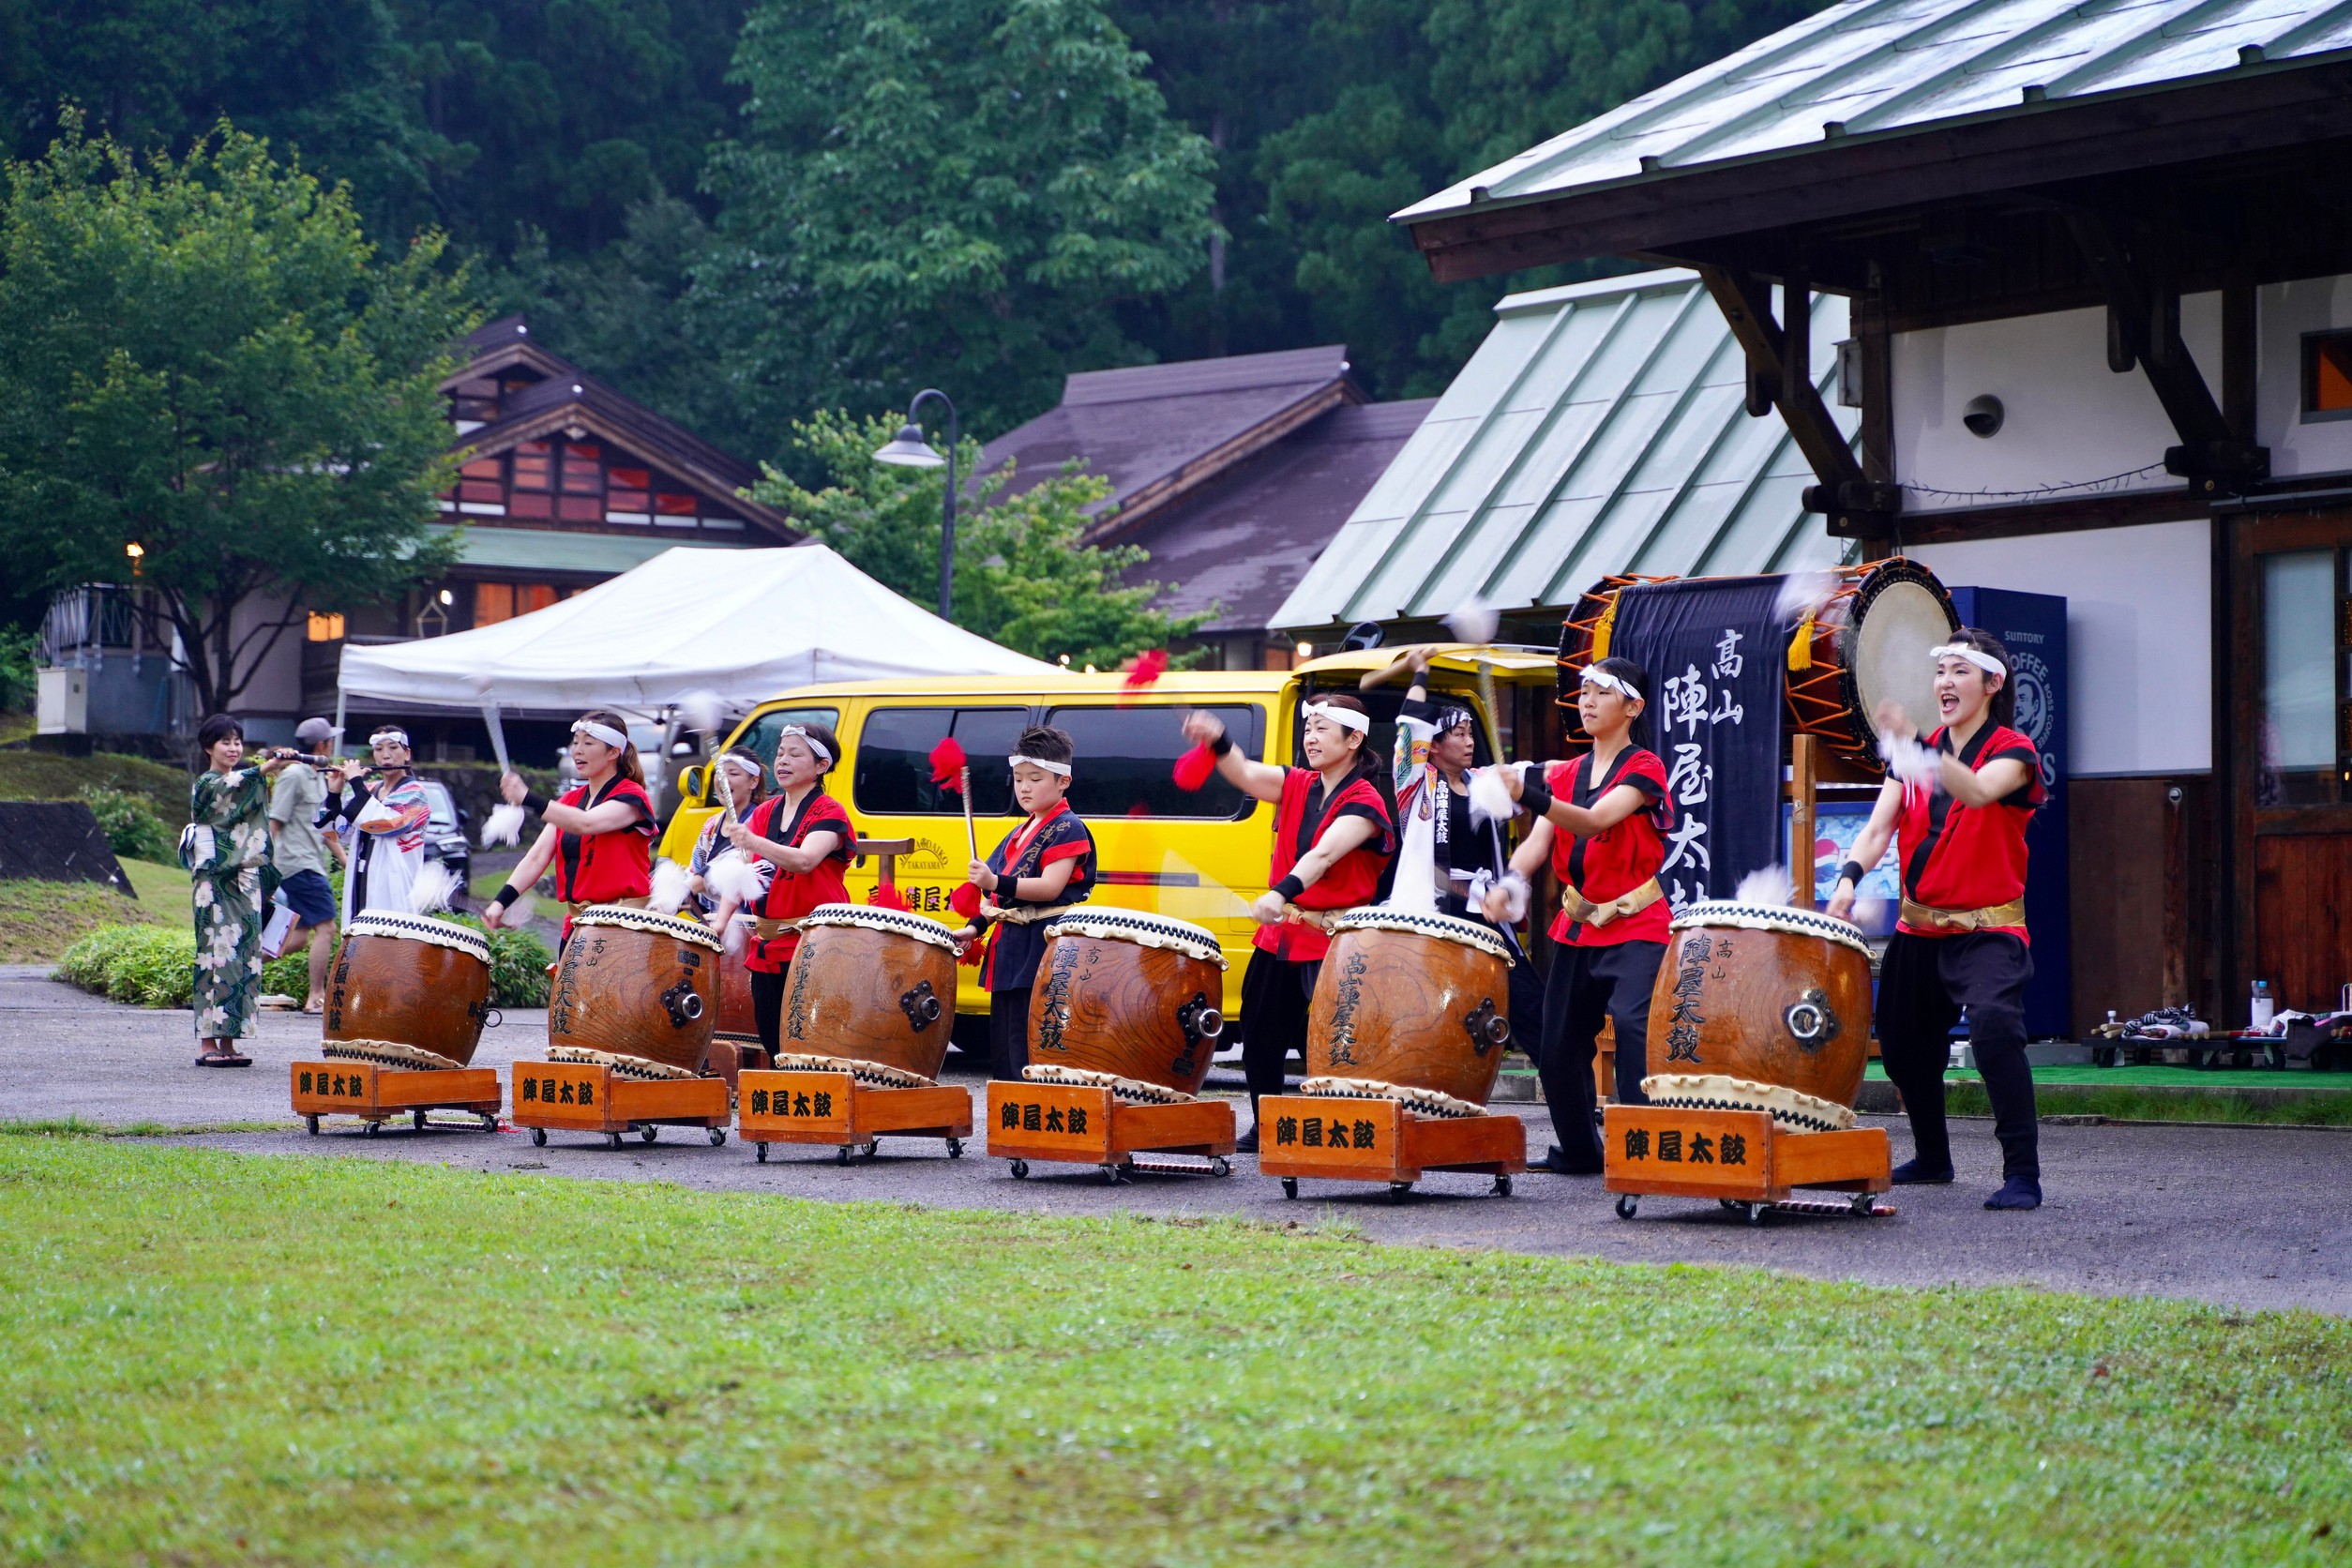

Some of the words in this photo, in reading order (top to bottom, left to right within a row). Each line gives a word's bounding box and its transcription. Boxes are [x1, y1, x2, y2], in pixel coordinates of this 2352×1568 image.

[2009, 652, 2048, 682] OFFEE
[2043, 683, 2055, 712] BOSS
[2036, 714, 2055, 749] COFFEE
[1436, 779, 1450, 844] 高山陣屋太鼓
[1038, 942, 1080, 1051] 陣屋太鼓
[1666, 935, 1712, 1064] 陣屋太鼓
[299, 1071, 363, 1097] 陣屋太鼓
[522, 1078, 594, 1106] 陣屋太鼓
[751, 1089, 832, 1118] 陣屋太鼓
[1001, 1101, 1088, 1135] 陣屋太鼓
[1276, 1116, 1376, 1150] 陣屋太鼓
[1624, 1128, 1747, 1166] 陣屋太鼓
